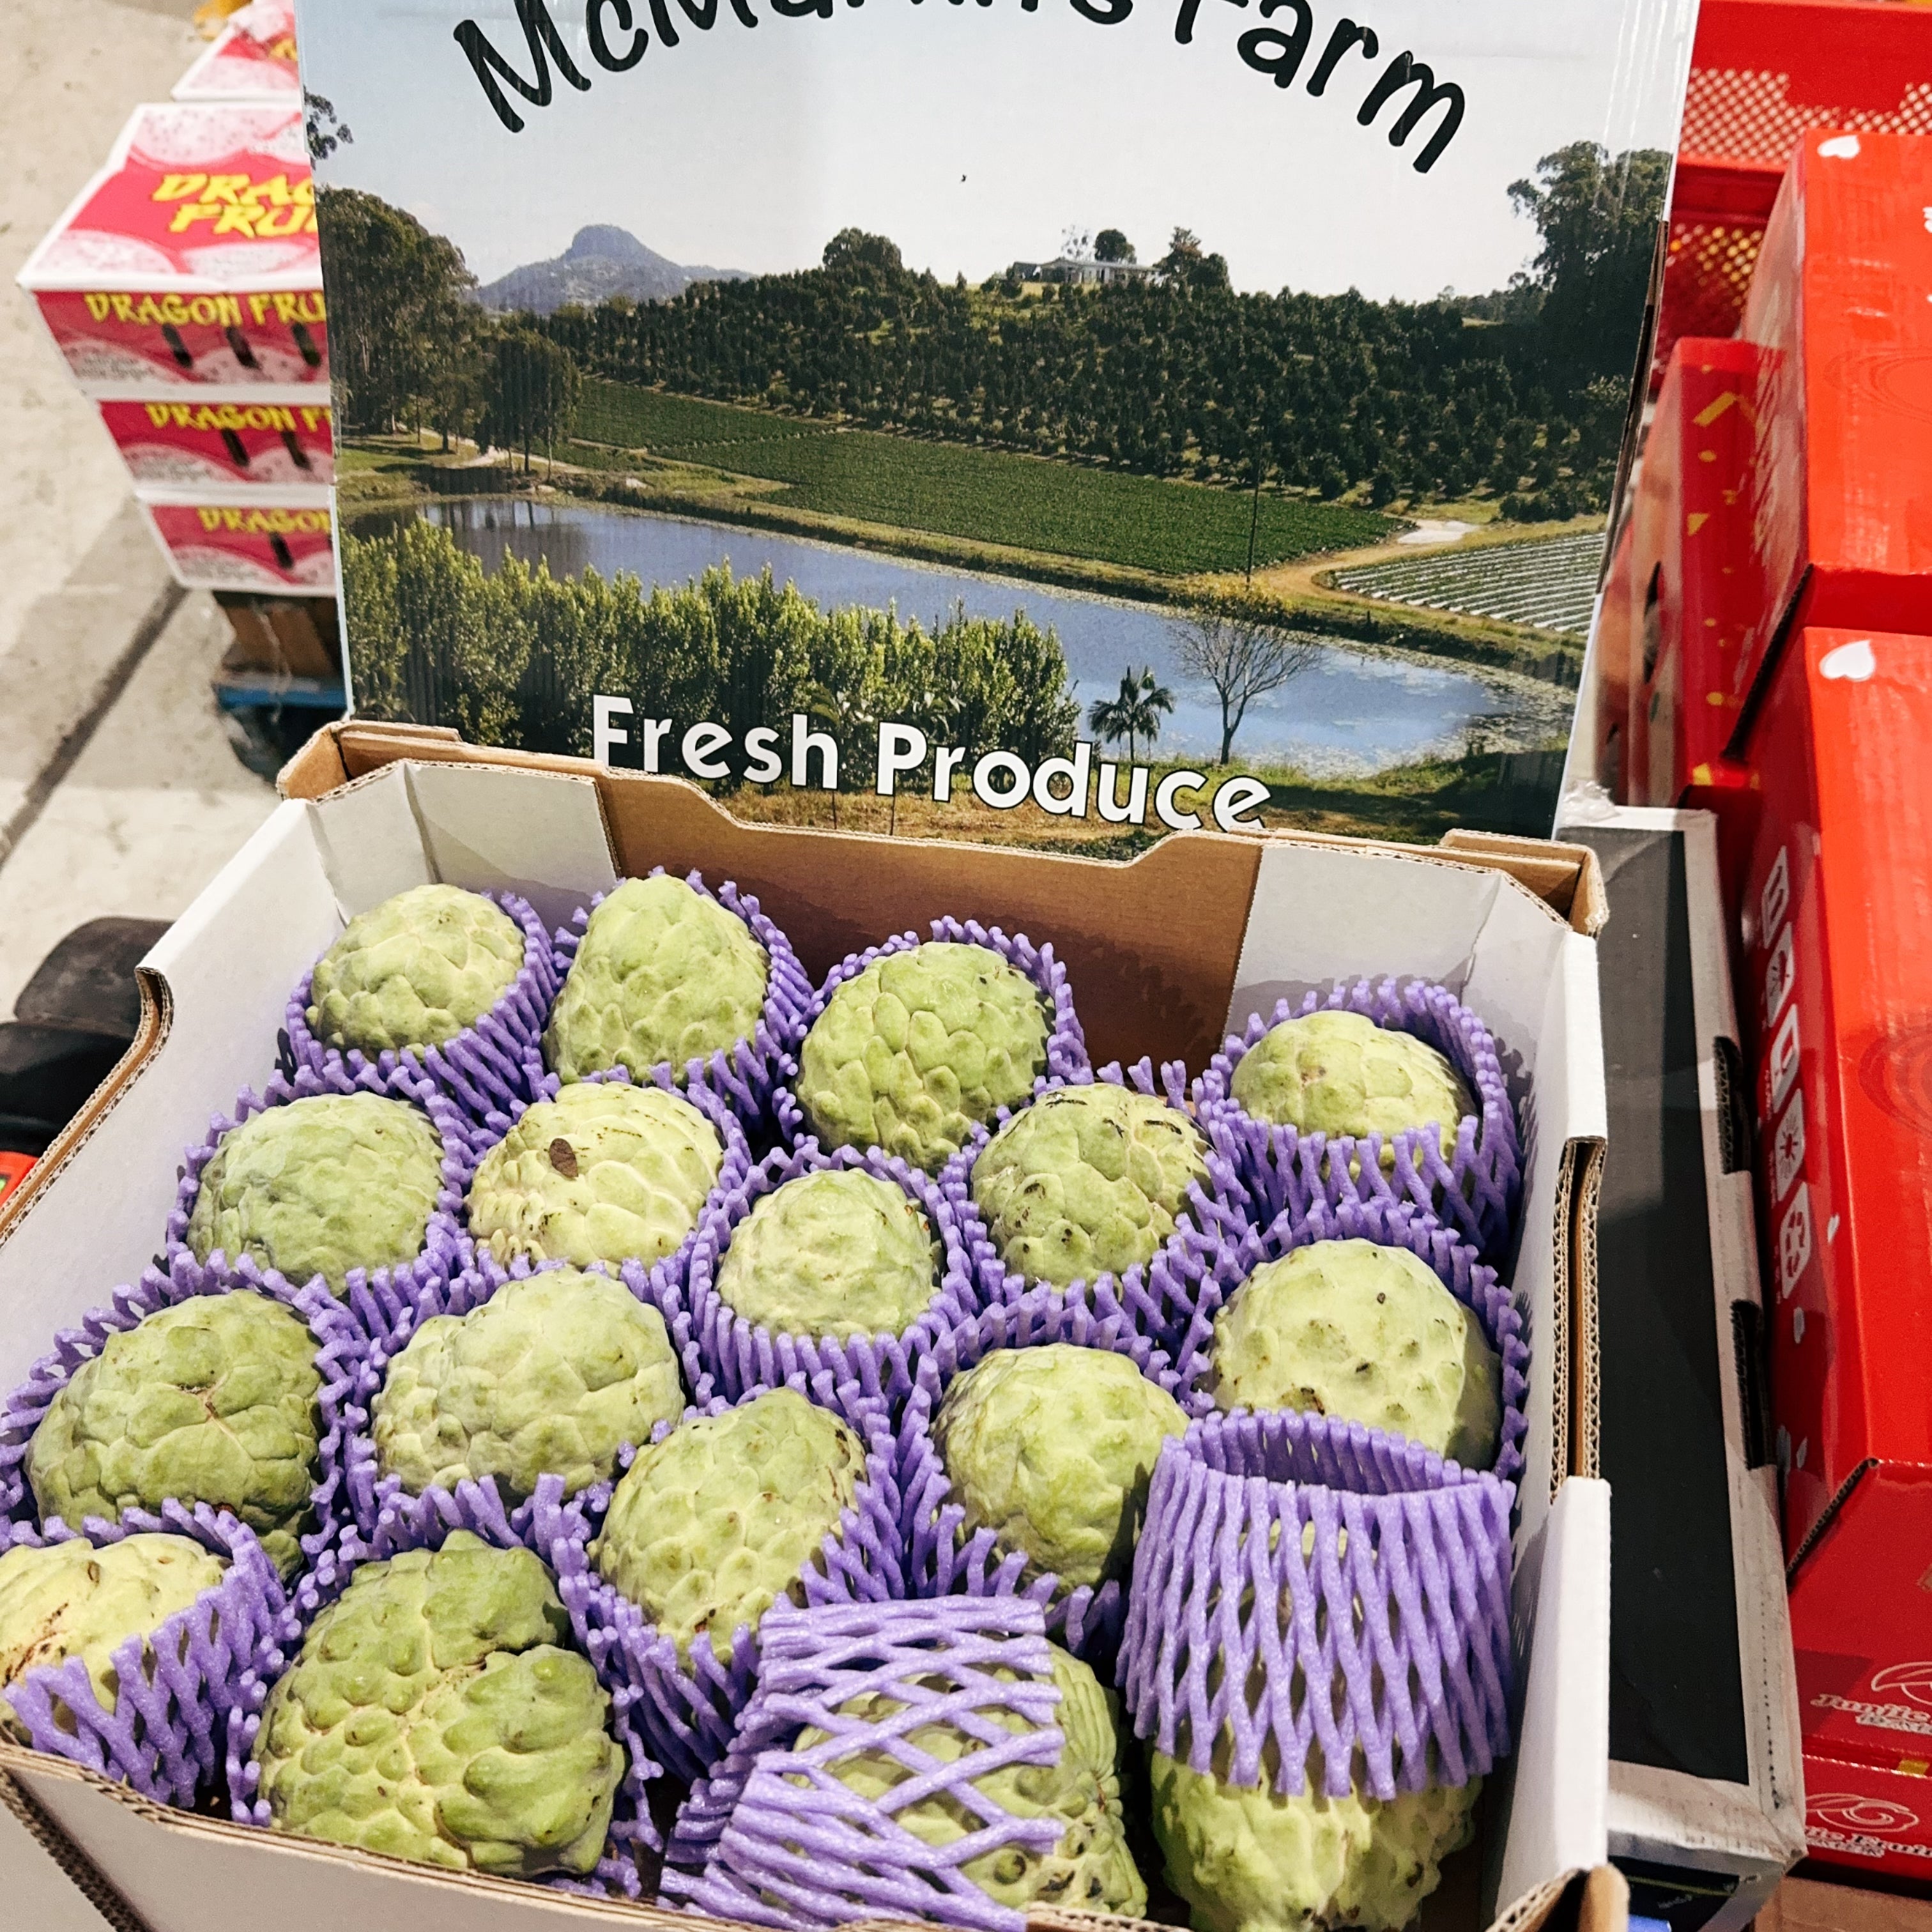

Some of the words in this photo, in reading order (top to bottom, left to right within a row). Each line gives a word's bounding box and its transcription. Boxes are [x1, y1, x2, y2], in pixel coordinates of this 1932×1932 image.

[84, 293, 243, 327] DRAGON
[144, 403, 297, 431] DRAGON
[593, 694, 838, 789] Fresh
[878, 722, 1271, 832] Produce
